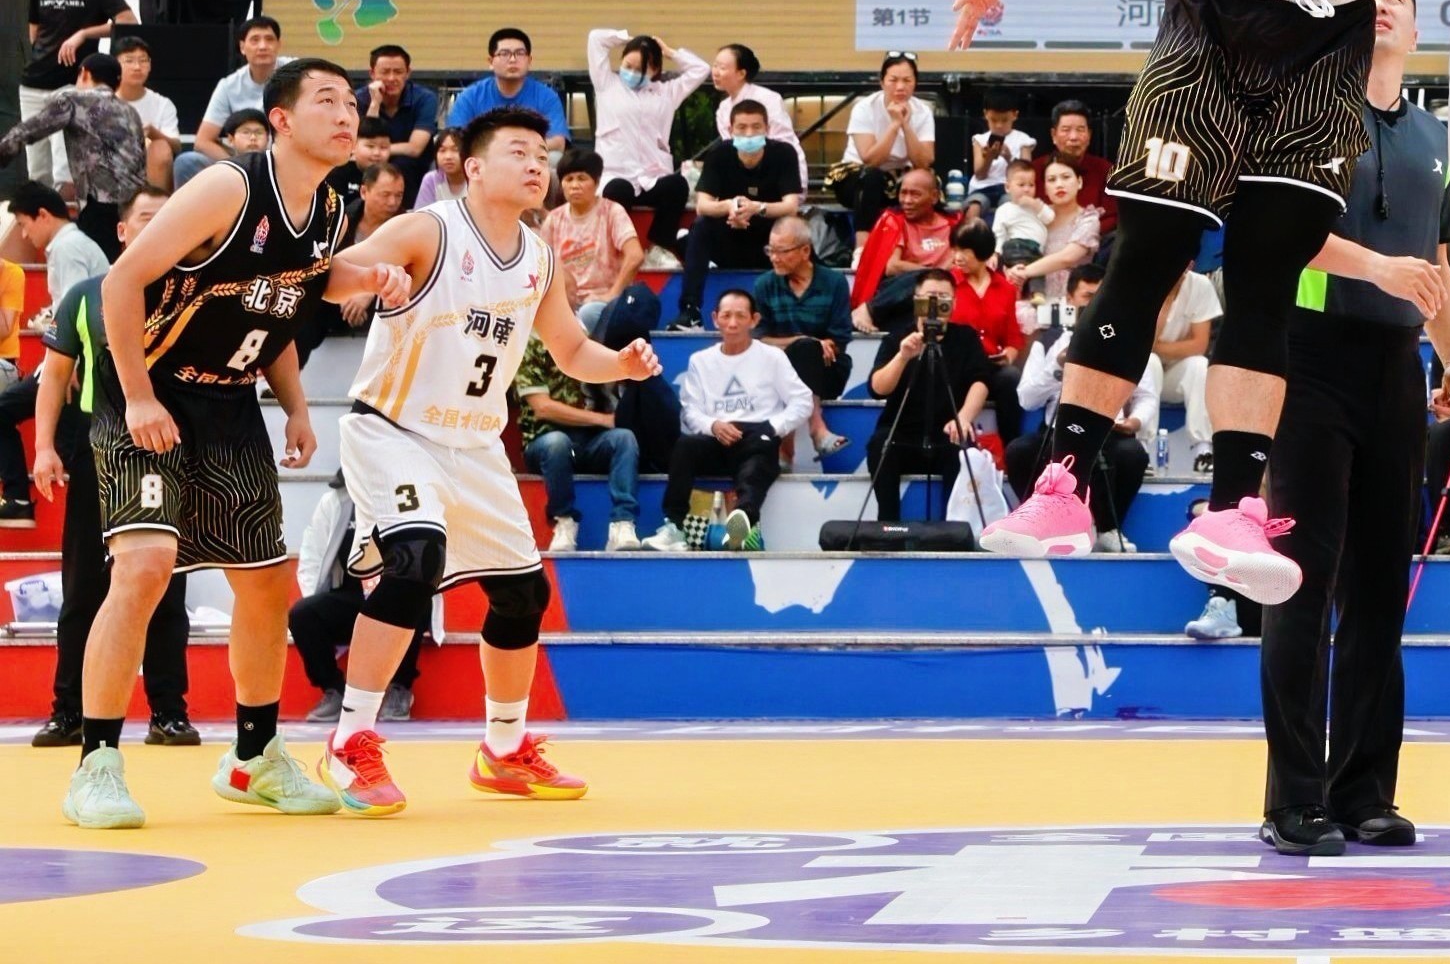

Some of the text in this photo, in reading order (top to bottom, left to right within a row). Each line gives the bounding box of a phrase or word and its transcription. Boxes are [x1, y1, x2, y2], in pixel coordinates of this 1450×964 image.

[873, 7, 931, 26] 第1节
[1145, 136, 1190, 182] 10
[243, 276, 304, 317] 北京
[463, 308, 516, 347] 河南
[227, 329, 269, 371] 8
[466, 354, 498, 397] 3
[140, 473, 163, 509] 8
[394, 483, 420, 513] 3
